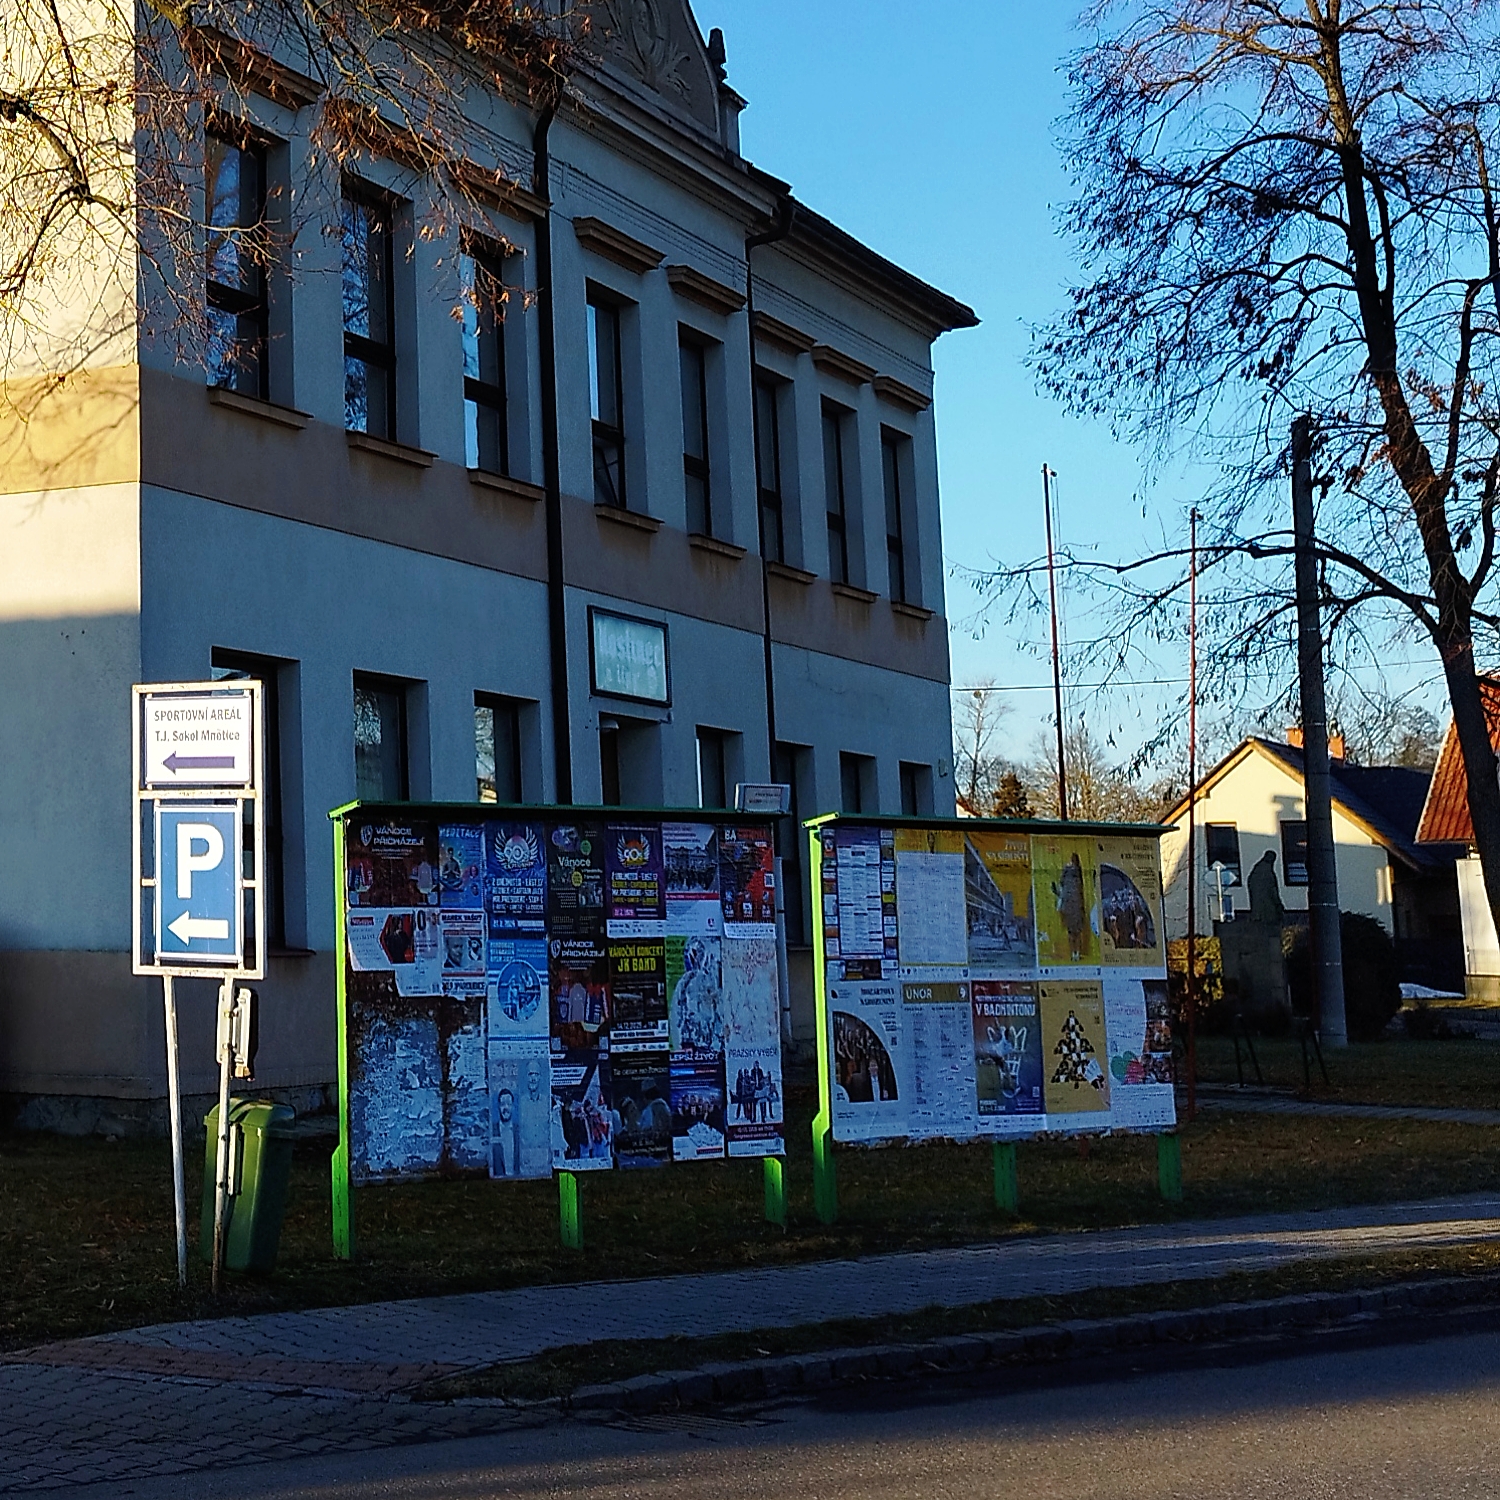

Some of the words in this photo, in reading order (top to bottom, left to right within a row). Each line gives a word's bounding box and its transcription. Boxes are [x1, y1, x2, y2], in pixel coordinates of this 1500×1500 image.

[154, 707, 208, 721] SPORTOVNÍ
[211, 707, 241, 721] AREÁL
[155, 731, 169, 742] T.J.
[173, 730, 198, 742] Sokol
[201, 728, 240, 741] Mnětice
[176, 822, 224, 900] P
[557, 855, 591, 868] Vánoce
[906, 986, 933, 1000] ÚNOR
[976, 1003, 982, 1016] V
[984, 1003, 1035, 1016] BADMINTONU
